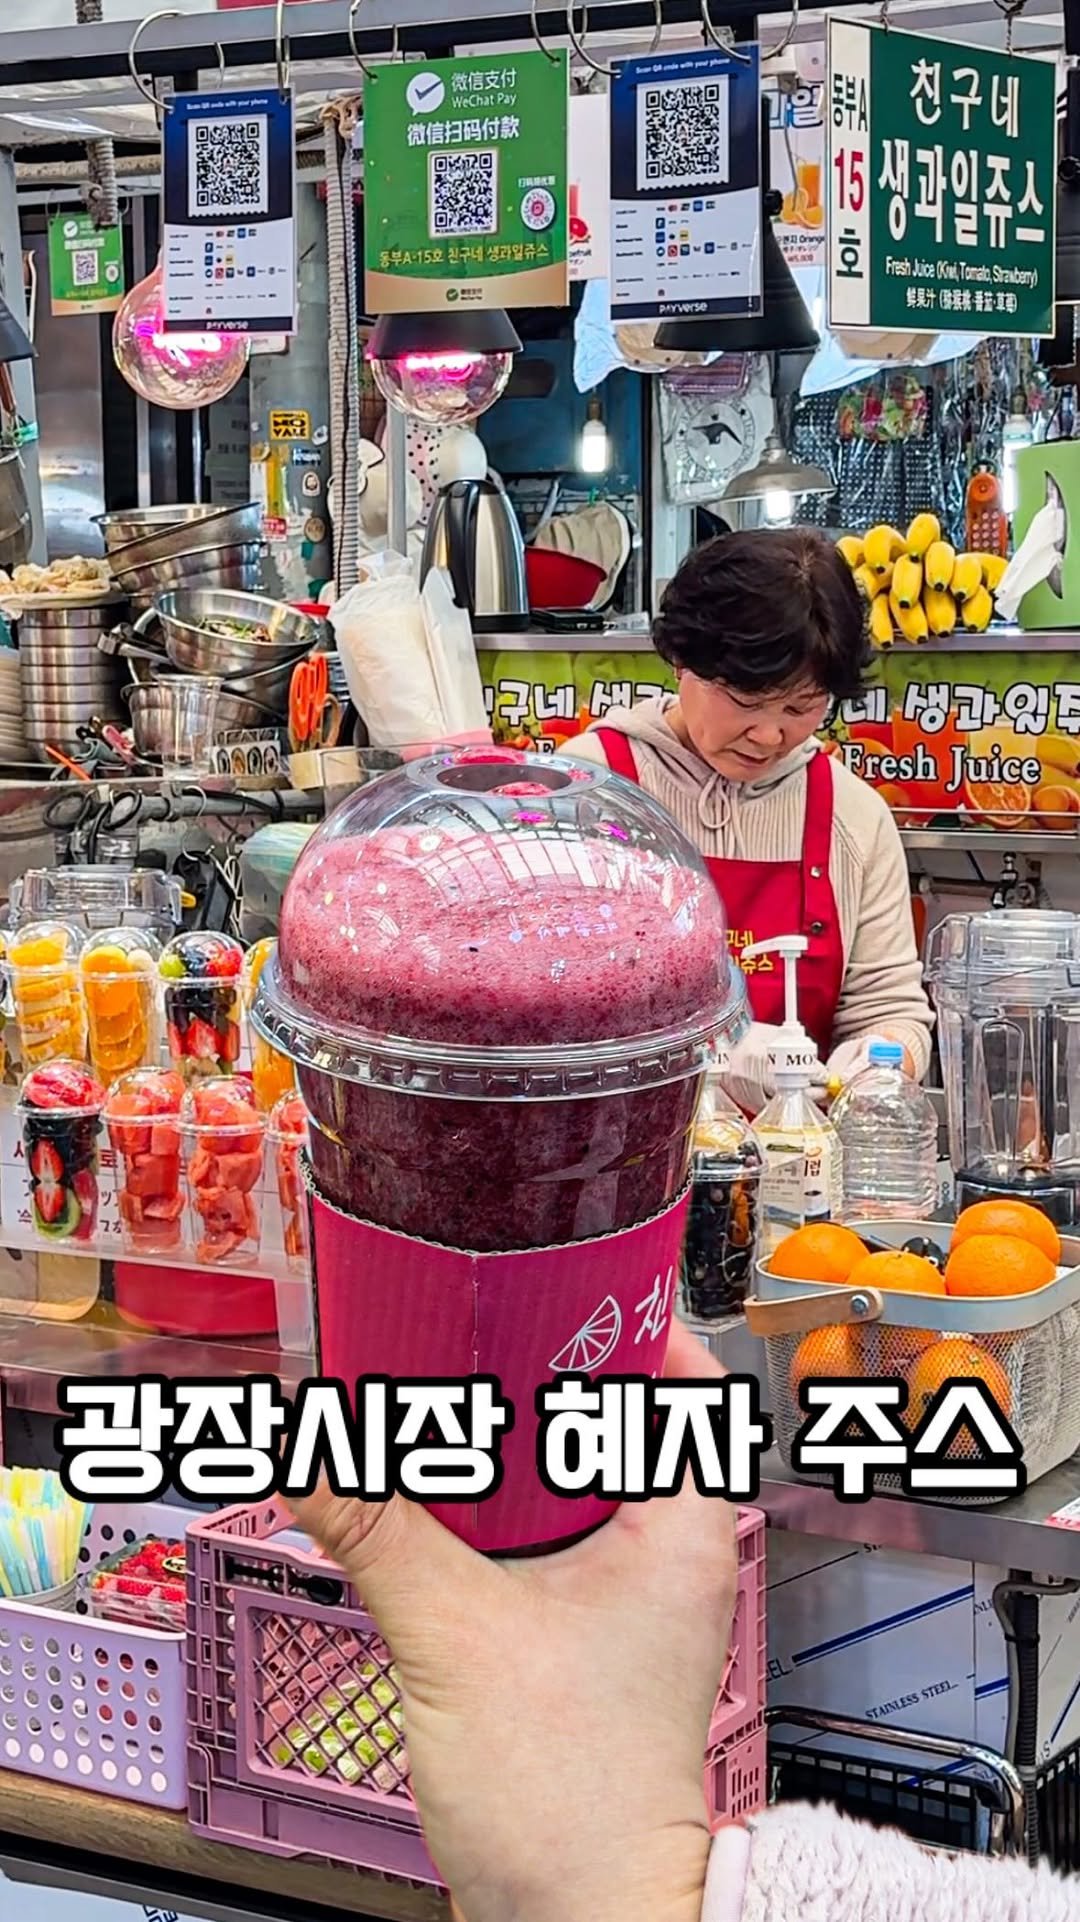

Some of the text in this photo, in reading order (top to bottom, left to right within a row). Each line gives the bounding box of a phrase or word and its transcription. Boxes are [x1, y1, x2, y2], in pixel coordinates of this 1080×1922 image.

[451, 68, 516, 92] 微信支付
[452, 93, 517, 109] WeChat Pay
[910, 57, 1020, 138] 친구네
[832, 73, 868, 132] 동부A
[407, 115, 520, 147] 微信扫码付款
[834, 148, 864, 212] 15
[878, 138, 1045, 249] 생과일쥬스
[447, 246, 483, 263] 친구네
[487, 243, 549, 262] 생과일쥬스
[836, 227, 864, 279] 호
[886, 256, 911, 275] Fresh
[912, 258, 936, 278] Juice
[959, 262, 992, 284] Tomato,
[993, 265, 1038, 289] Strawberry)
[841, 744, 1042, 792] Fresh Juice
[865, 1680, 953, 1719] STAINLESS STEEL
